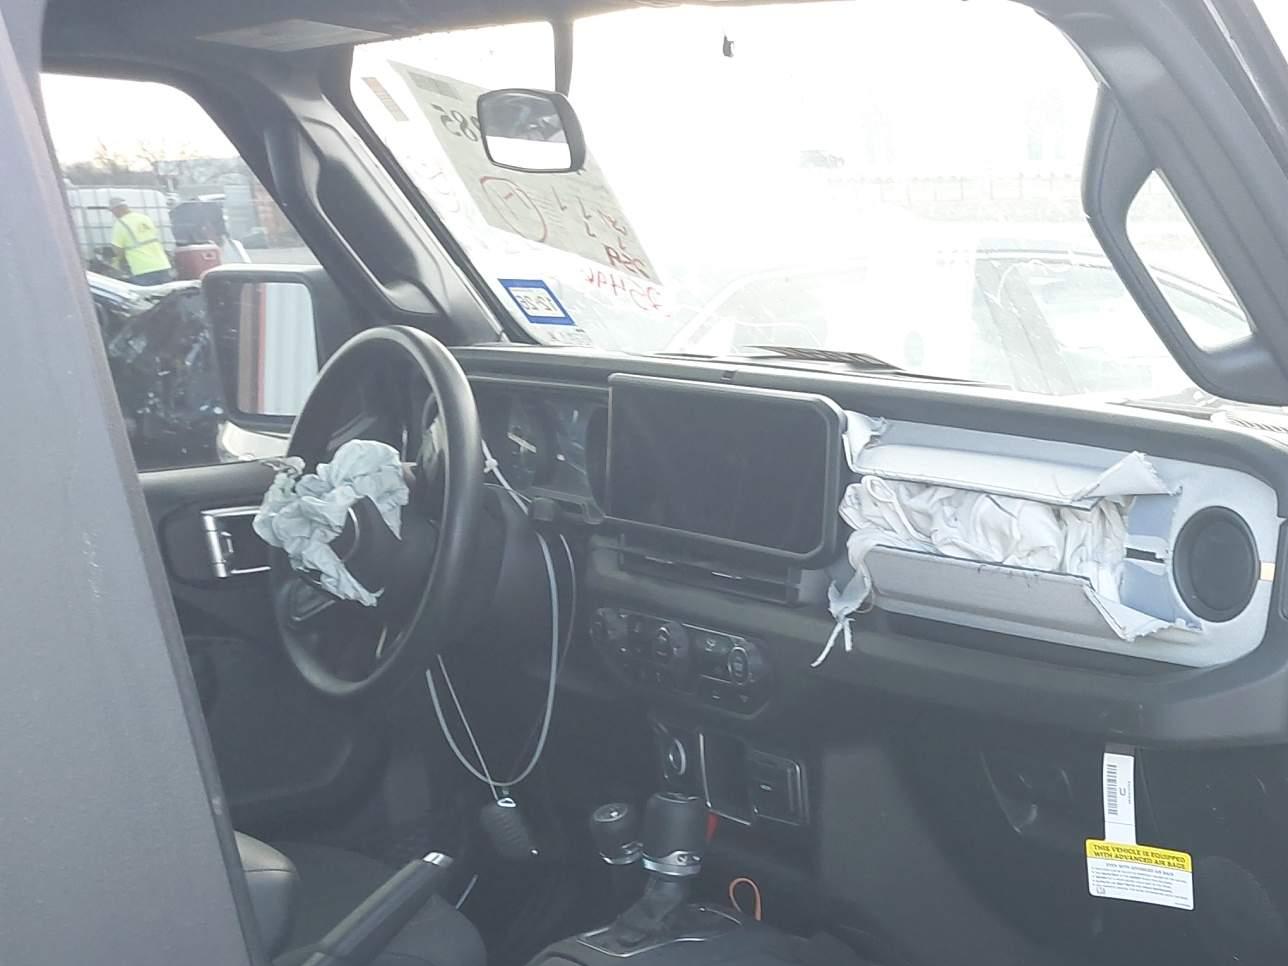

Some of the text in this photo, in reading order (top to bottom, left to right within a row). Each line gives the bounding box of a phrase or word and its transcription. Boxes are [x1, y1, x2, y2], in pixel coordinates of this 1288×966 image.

[1112, 847, 1140, 855] VEHICLE
[1151, 852, 1185, 863] EQUIPPED
[1115, 854, 1152, 863] ADVANCED
[1168, 861, 1185, 869] BAGS
